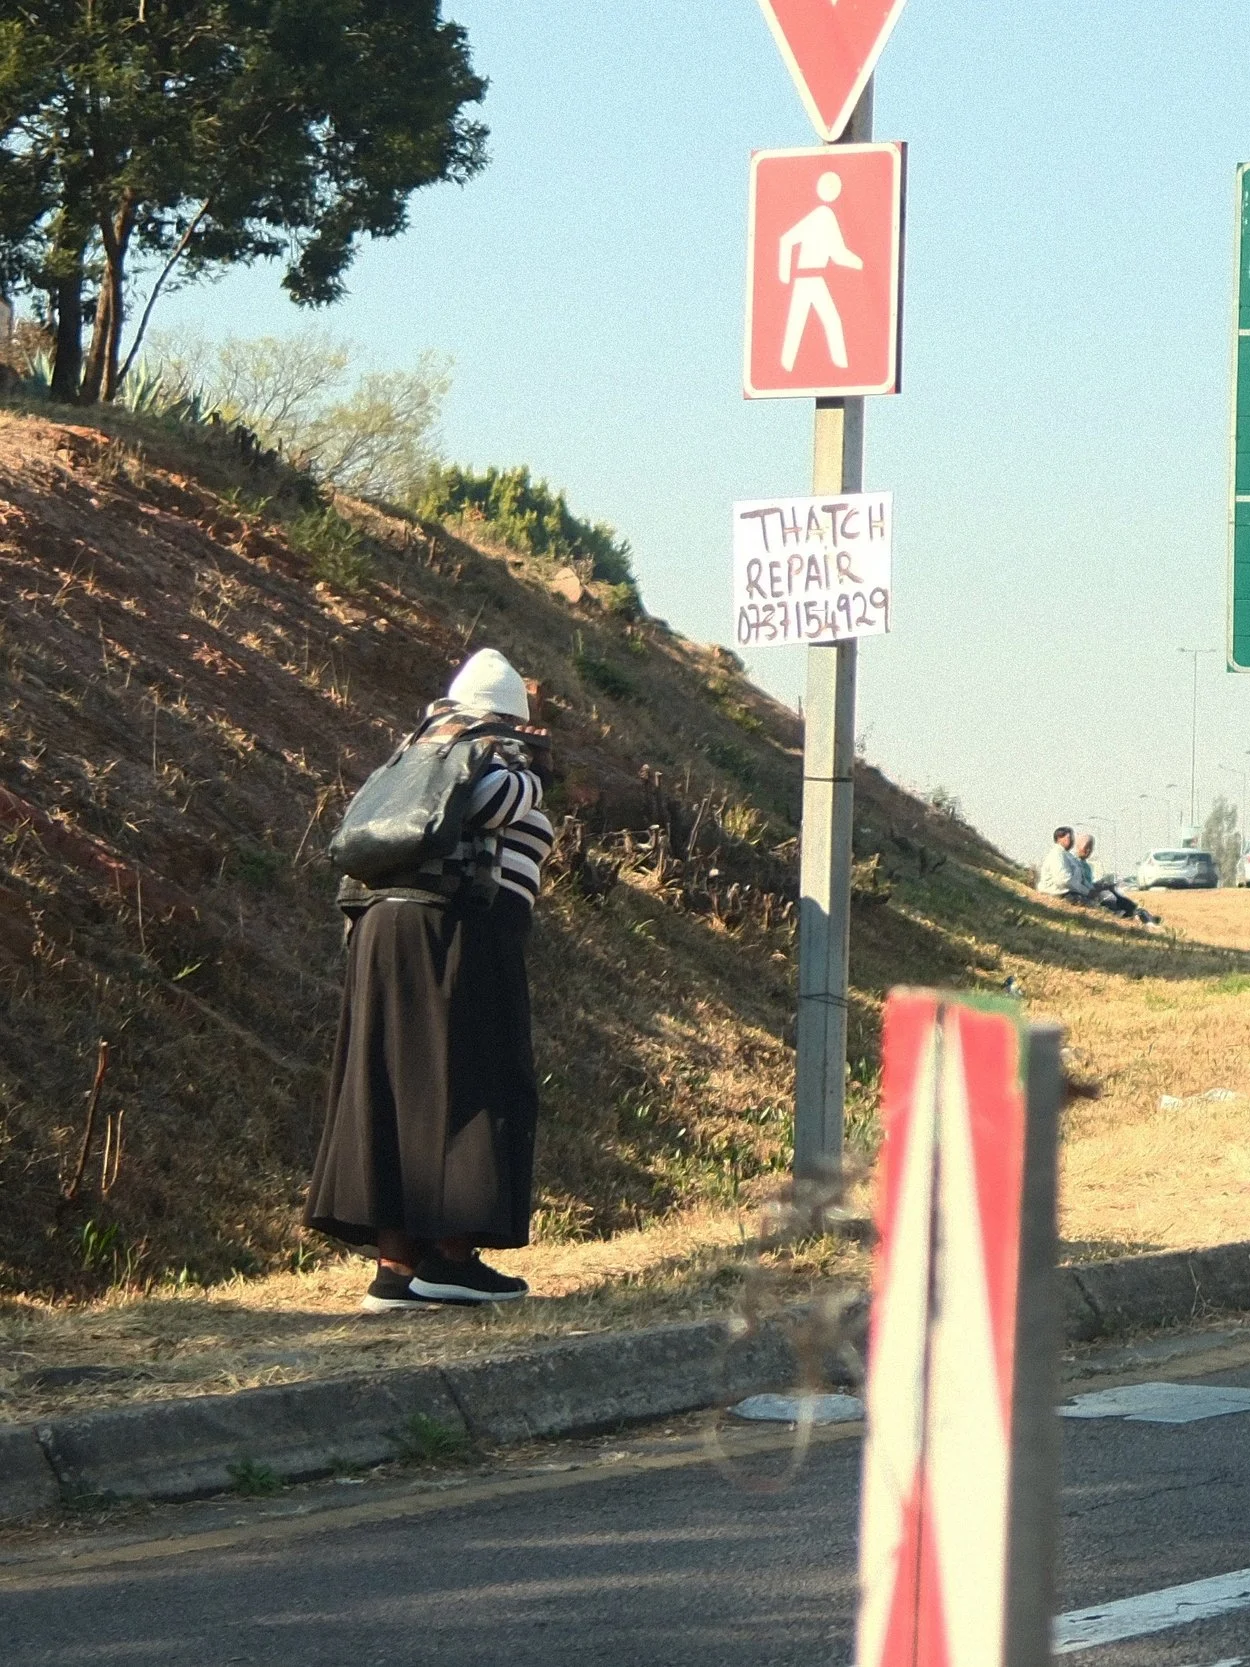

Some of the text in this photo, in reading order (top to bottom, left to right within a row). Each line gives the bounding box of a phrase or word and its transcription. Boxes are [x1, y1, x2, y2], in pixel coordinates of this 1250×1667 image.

[740, 503, 885, 552] THATCH
[746, 551, 864, 600] REPAIR
[738, 587, 891, 645] 0737154929
